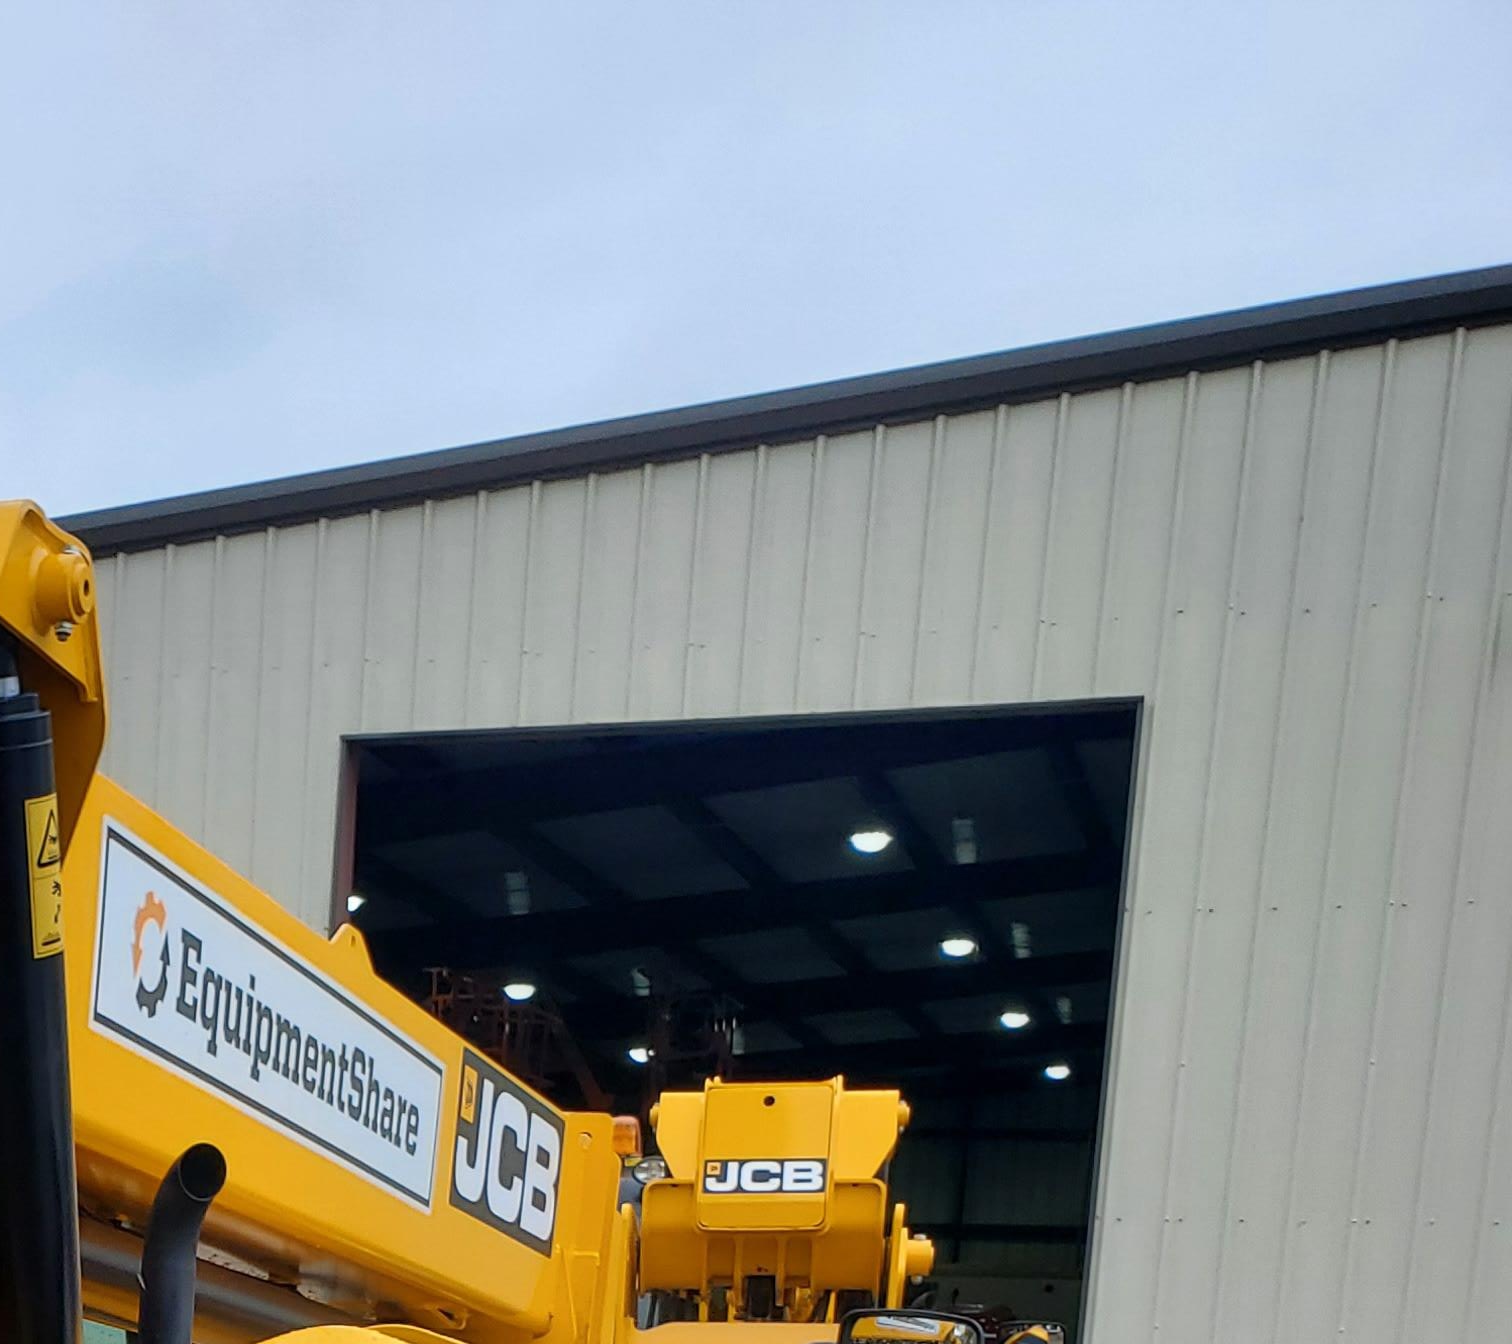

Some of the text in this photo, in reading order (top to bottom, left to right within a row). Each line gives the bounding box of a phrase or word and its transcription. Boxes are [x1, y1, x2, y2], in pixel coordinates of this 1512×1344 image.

[176, 928, 419, 1156] EquipmentShare
[455, 1078, 560, 1241] JCB
[705, 1161, 823, 1191] JCB
